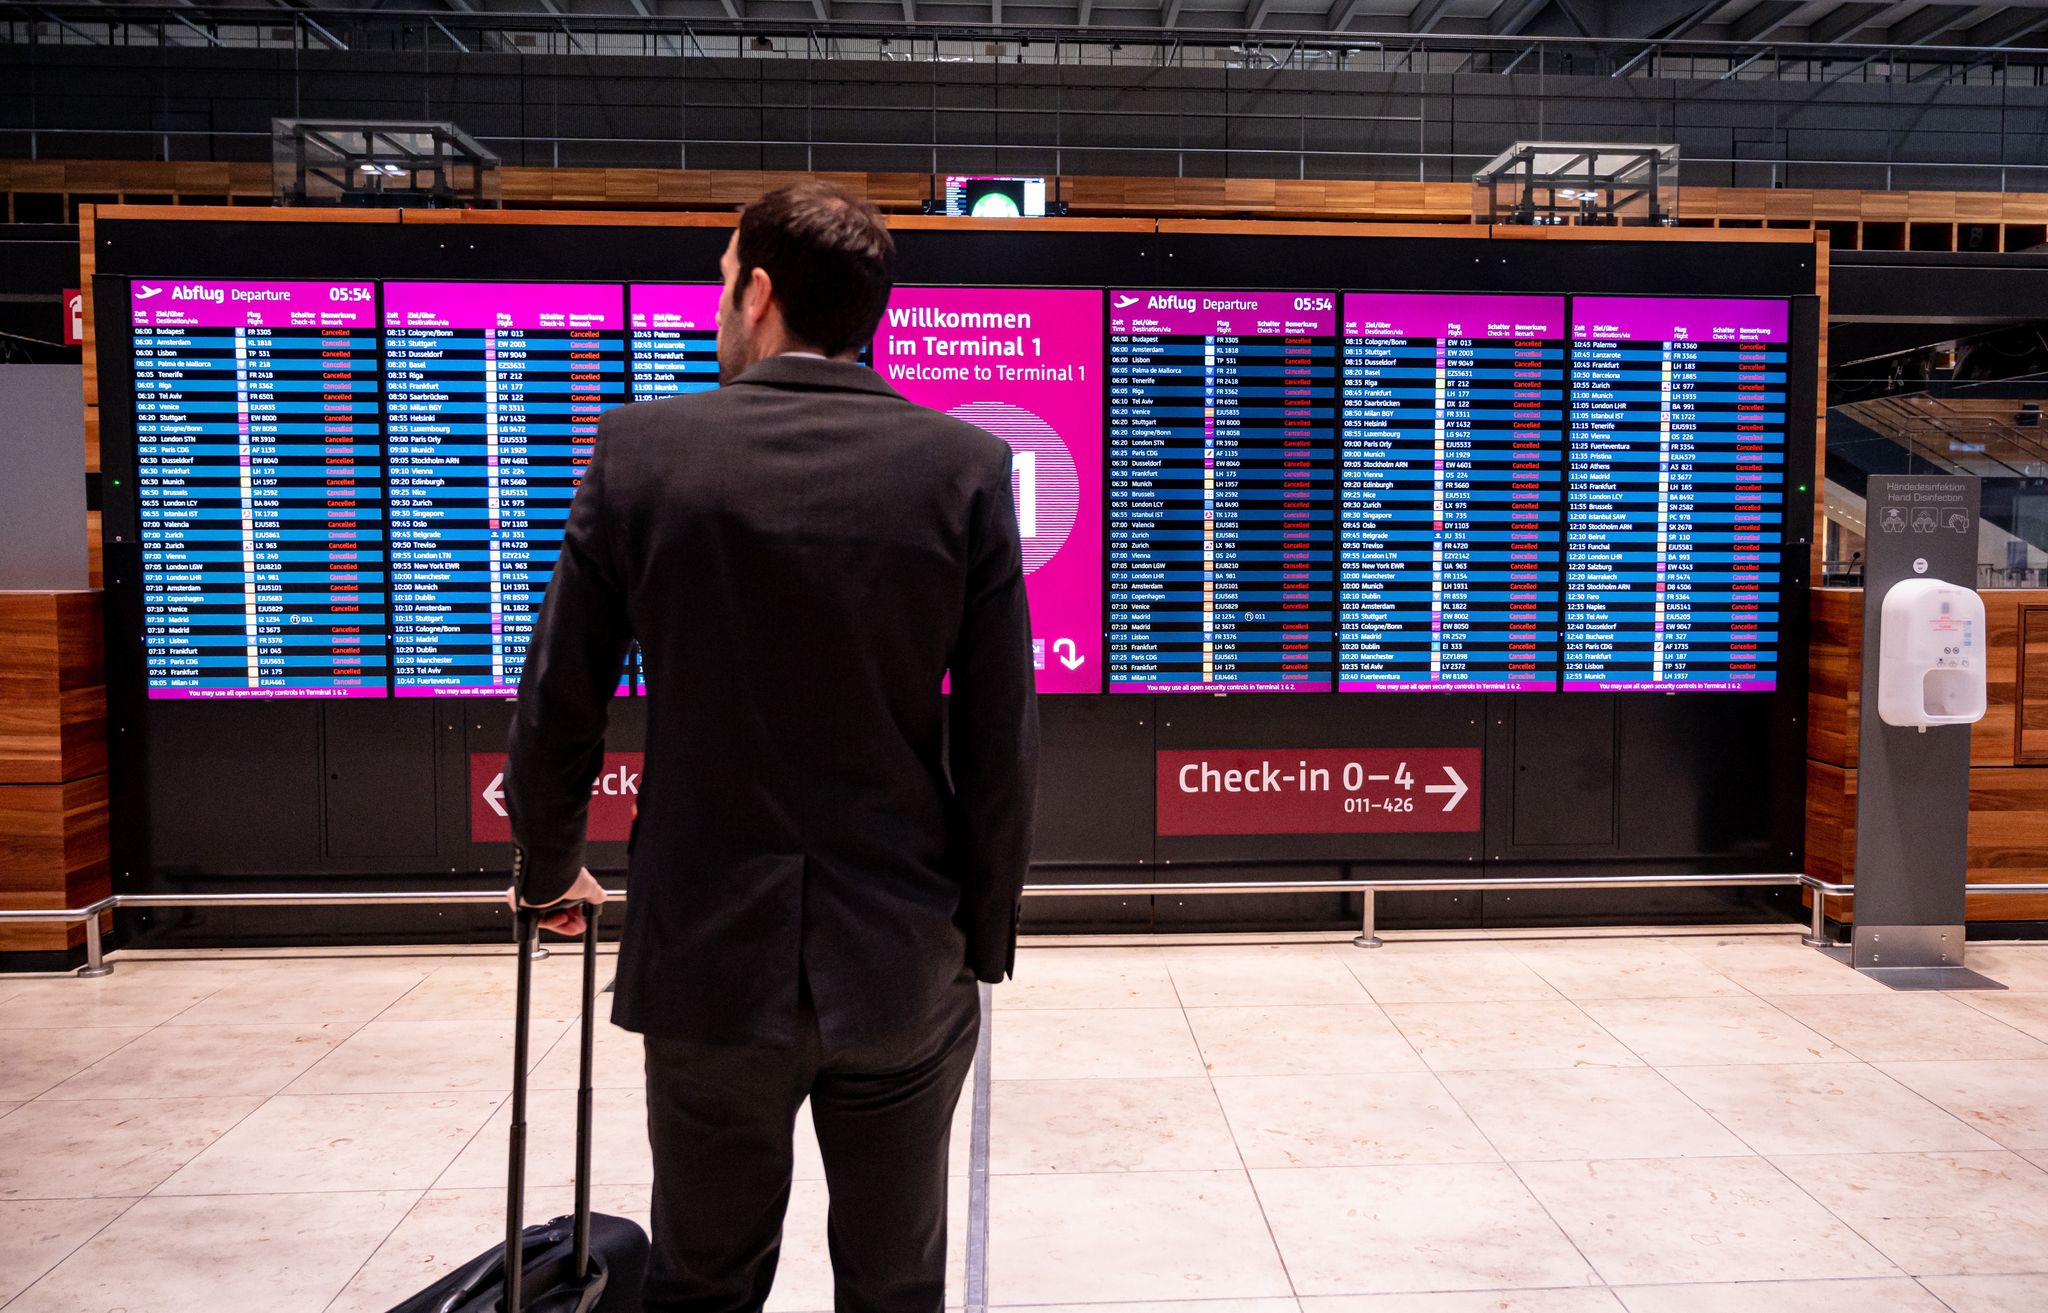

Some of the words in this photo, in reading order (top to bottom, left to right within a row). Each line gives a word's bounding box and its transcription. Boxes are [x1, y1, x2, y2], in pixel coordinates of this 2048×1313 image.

[172, 285, 224, 304] Abflug
[232, 289, 290, 303] Departure
[330, 288, 371, 301] 05:54
[1148, 295, 1196, 313] Abflug
[1203, 299, 1257, 312] Departure
[1294, 298, 1332, 310] 05:54
[888, 307, 1030, 328] Willkommen
[1217, 320, 1229, 329] Flug
[408, 329, 453, 338] Cologne/Bonn
[889, 335, 916, 355] im
[923, 336, 1024, 356] Terminal
[1032, 338, 1040, 356] 1
[889, 363, 969, 380] Welcome
[974, 365, 991, 380] to
[996, 364, 1073, 381] Terminal
[1079, 366, 1084, 381] 1
[1365, 379, 1378, 387] Riga
[1132, 419, 1156, 427] Stuttgart
[1888, 493, 1911, 501] Hand
[1914, 493, 1963, 501] Disinfection
[1587, 563, 1612, 571] Salzburg
[416, 625, 460, 633] Cologne/Bonn
[1179, 761, 1329, 792] Check-in
